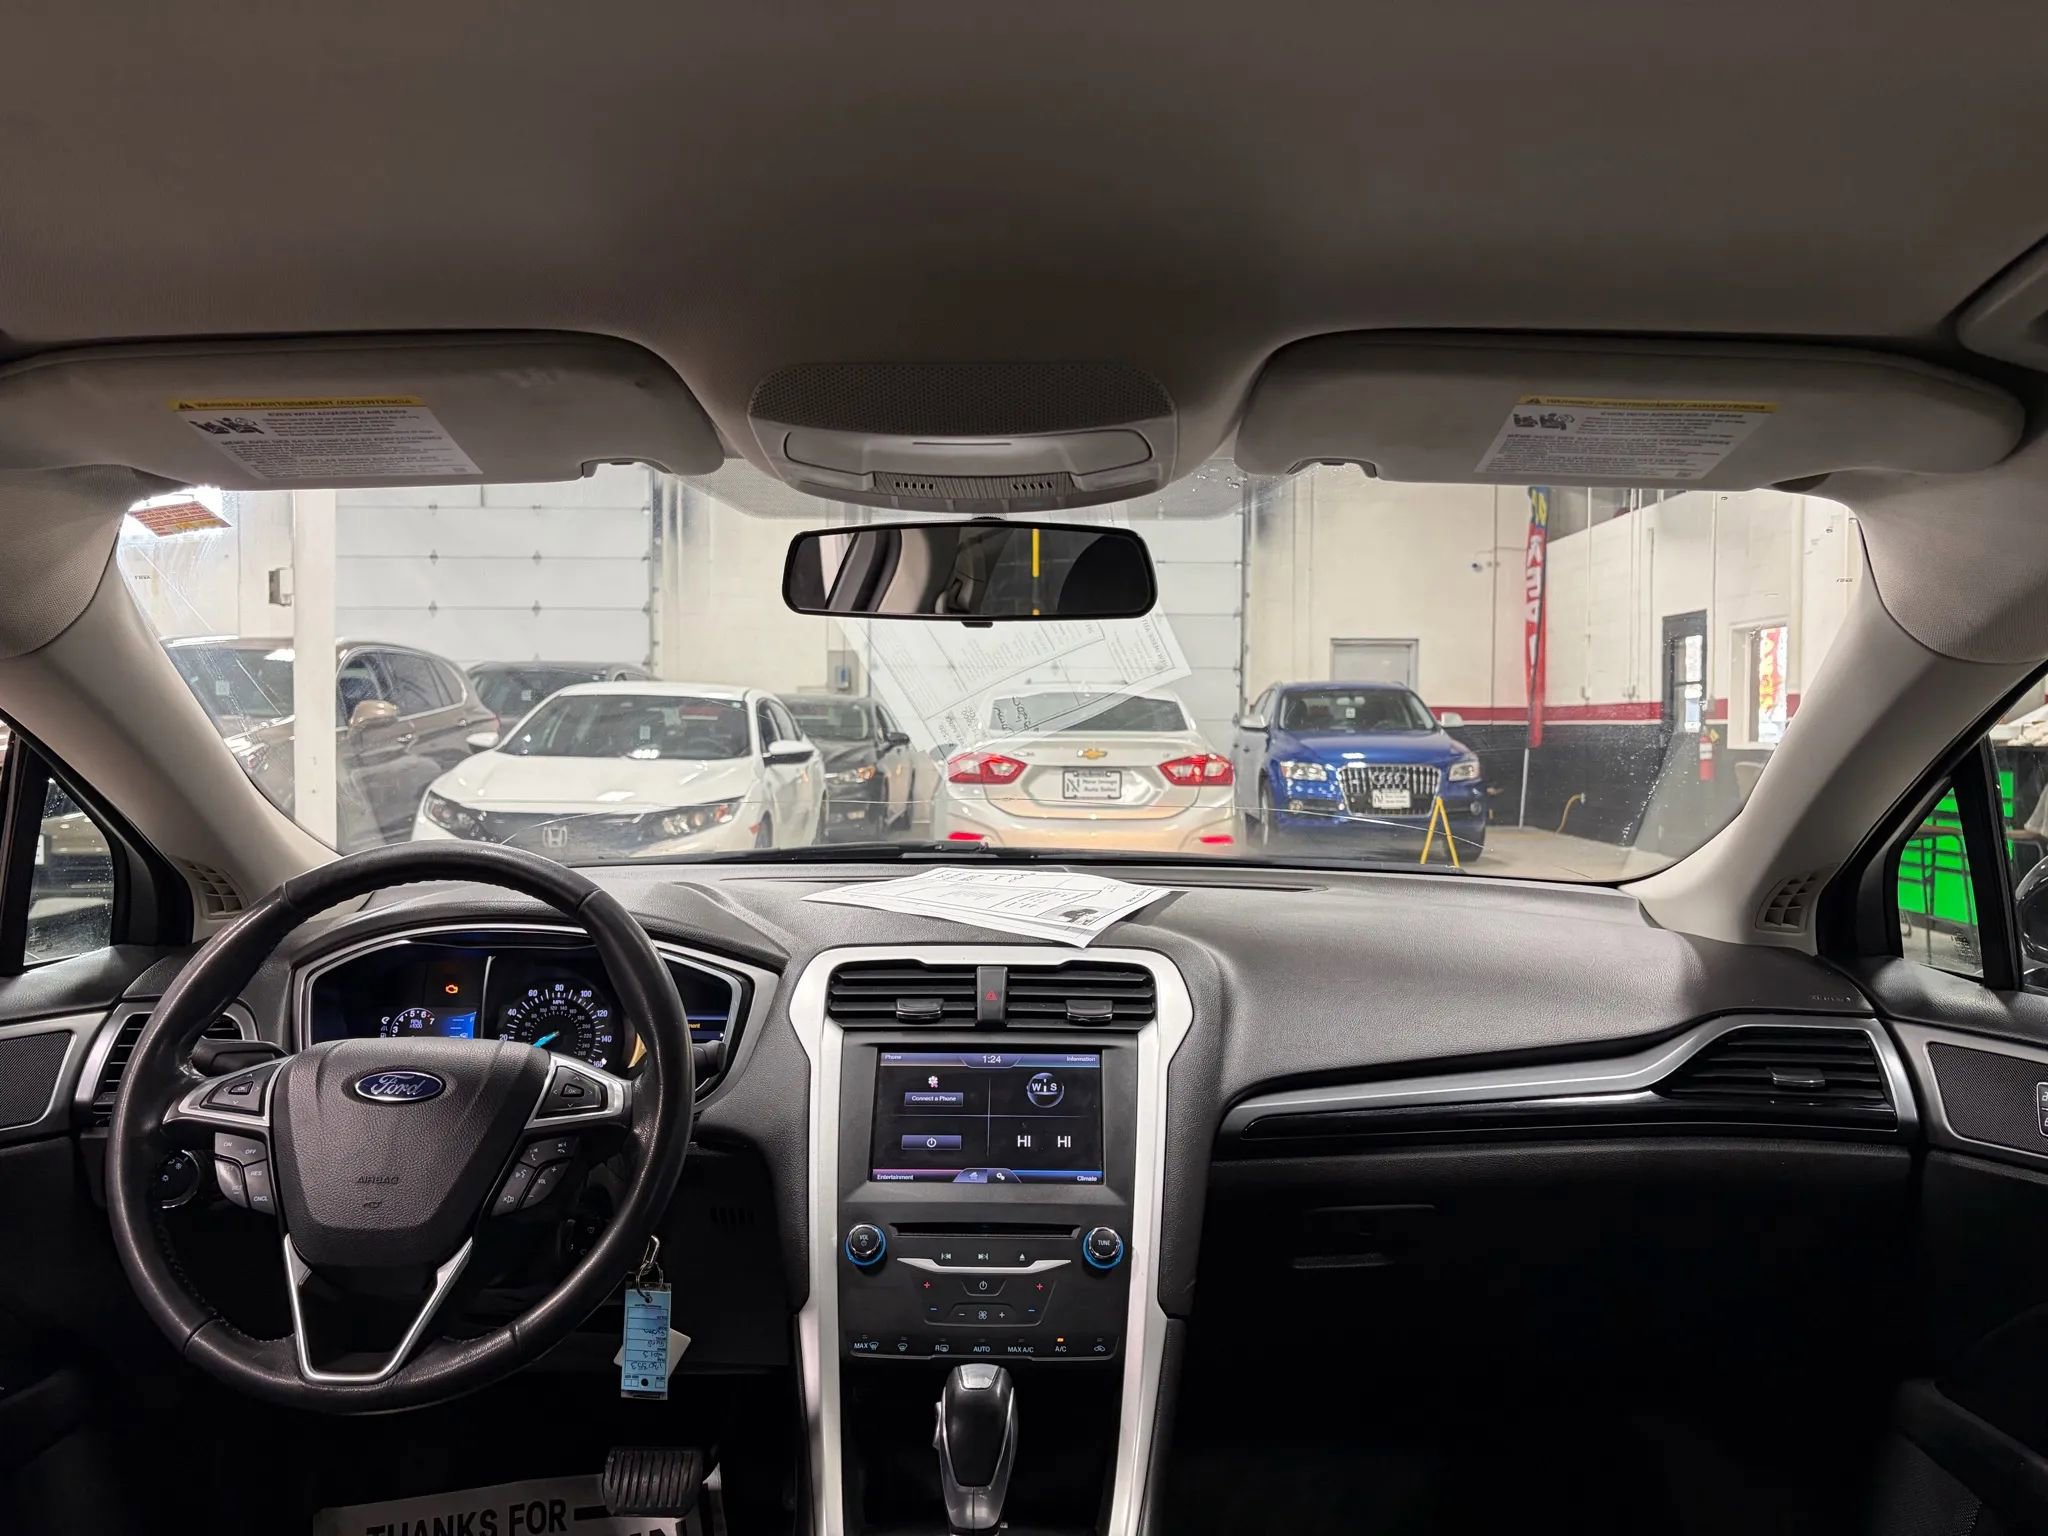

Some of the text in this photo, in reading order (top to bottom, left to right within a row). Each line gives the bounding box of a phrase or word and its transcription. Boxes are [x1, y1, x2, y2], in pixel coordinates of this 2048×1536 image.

[601, 1035, 612, 1043] 140
[982, 1055, 1002, 1064] 1:24
[370, 1074, 426, 1095] Ford
[1031, 1082, 1057, 1091] W S
[1017, 1135, 1071, 1148] HI HI
[507, 1499, 567, 1536] FOR
